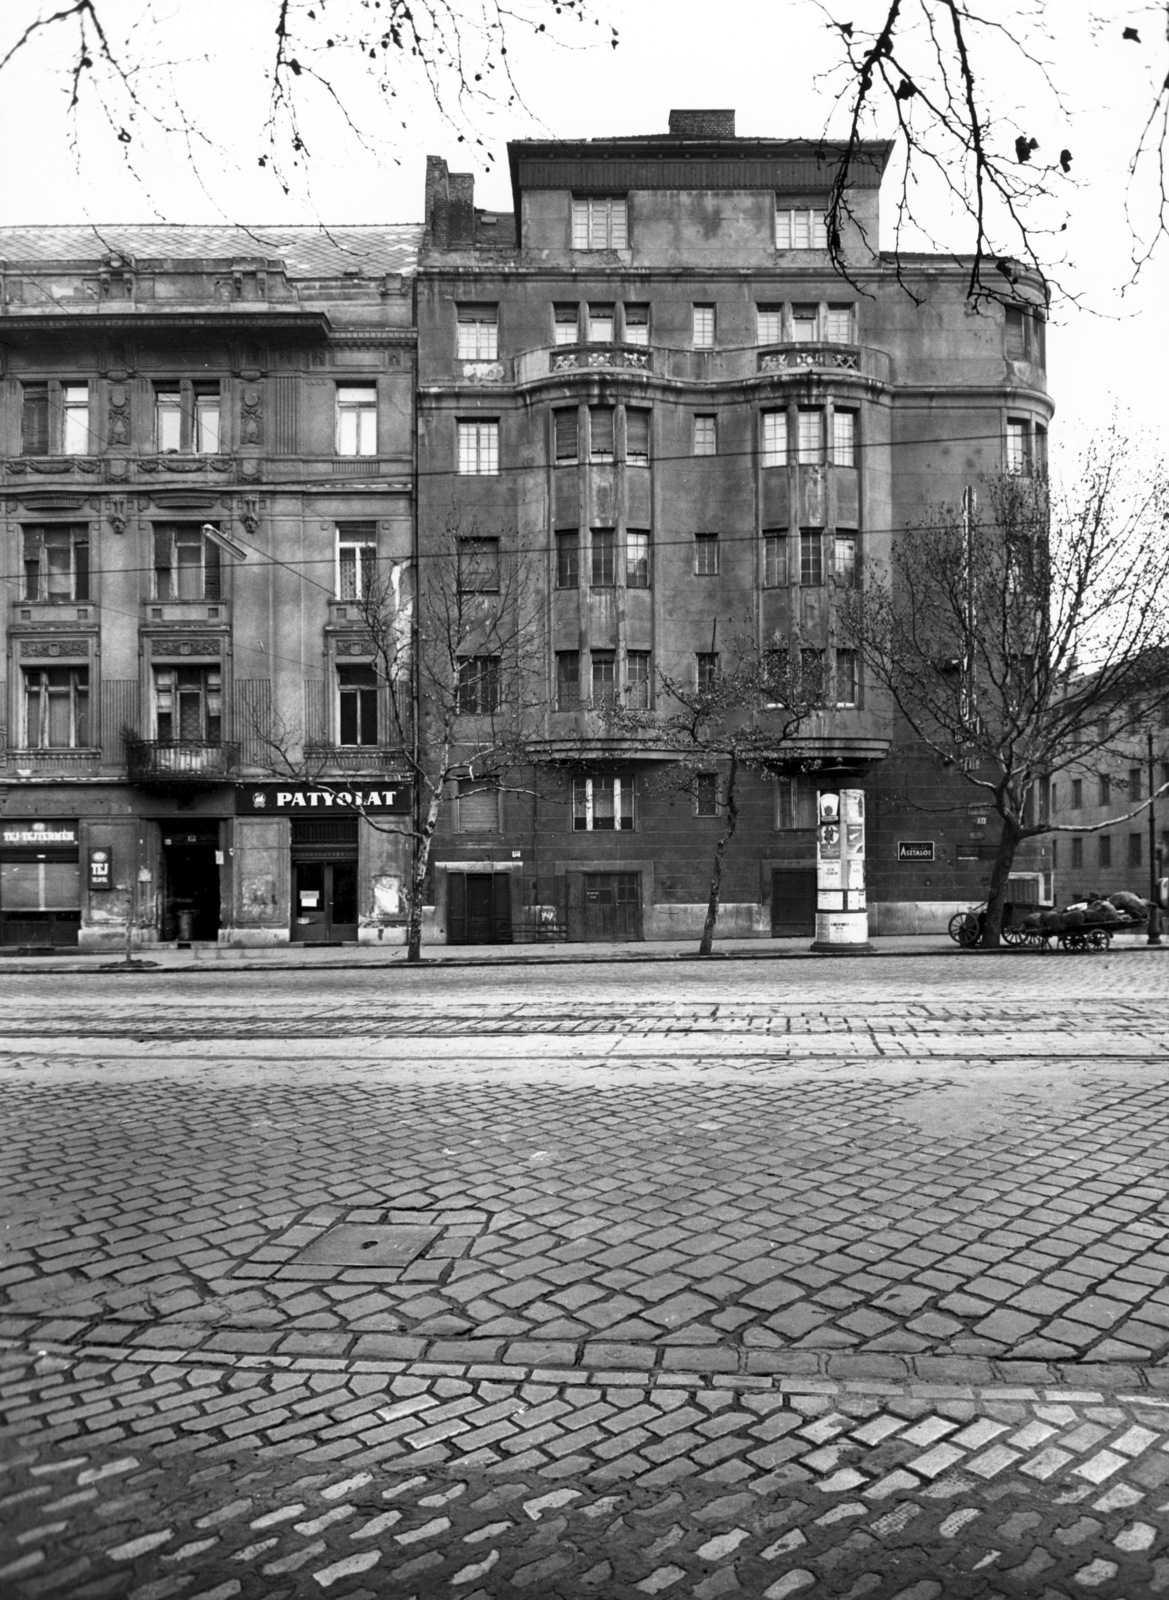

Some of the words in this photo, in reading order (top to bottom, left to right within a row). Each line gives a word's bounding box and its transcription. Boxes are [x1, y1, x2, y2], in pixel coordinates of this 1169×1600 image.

[276, 791, 397, 806] PATYOLAT
[900, 845, 931, 856] ASZTALOS
[91, 863, 108, 875] TEJ
